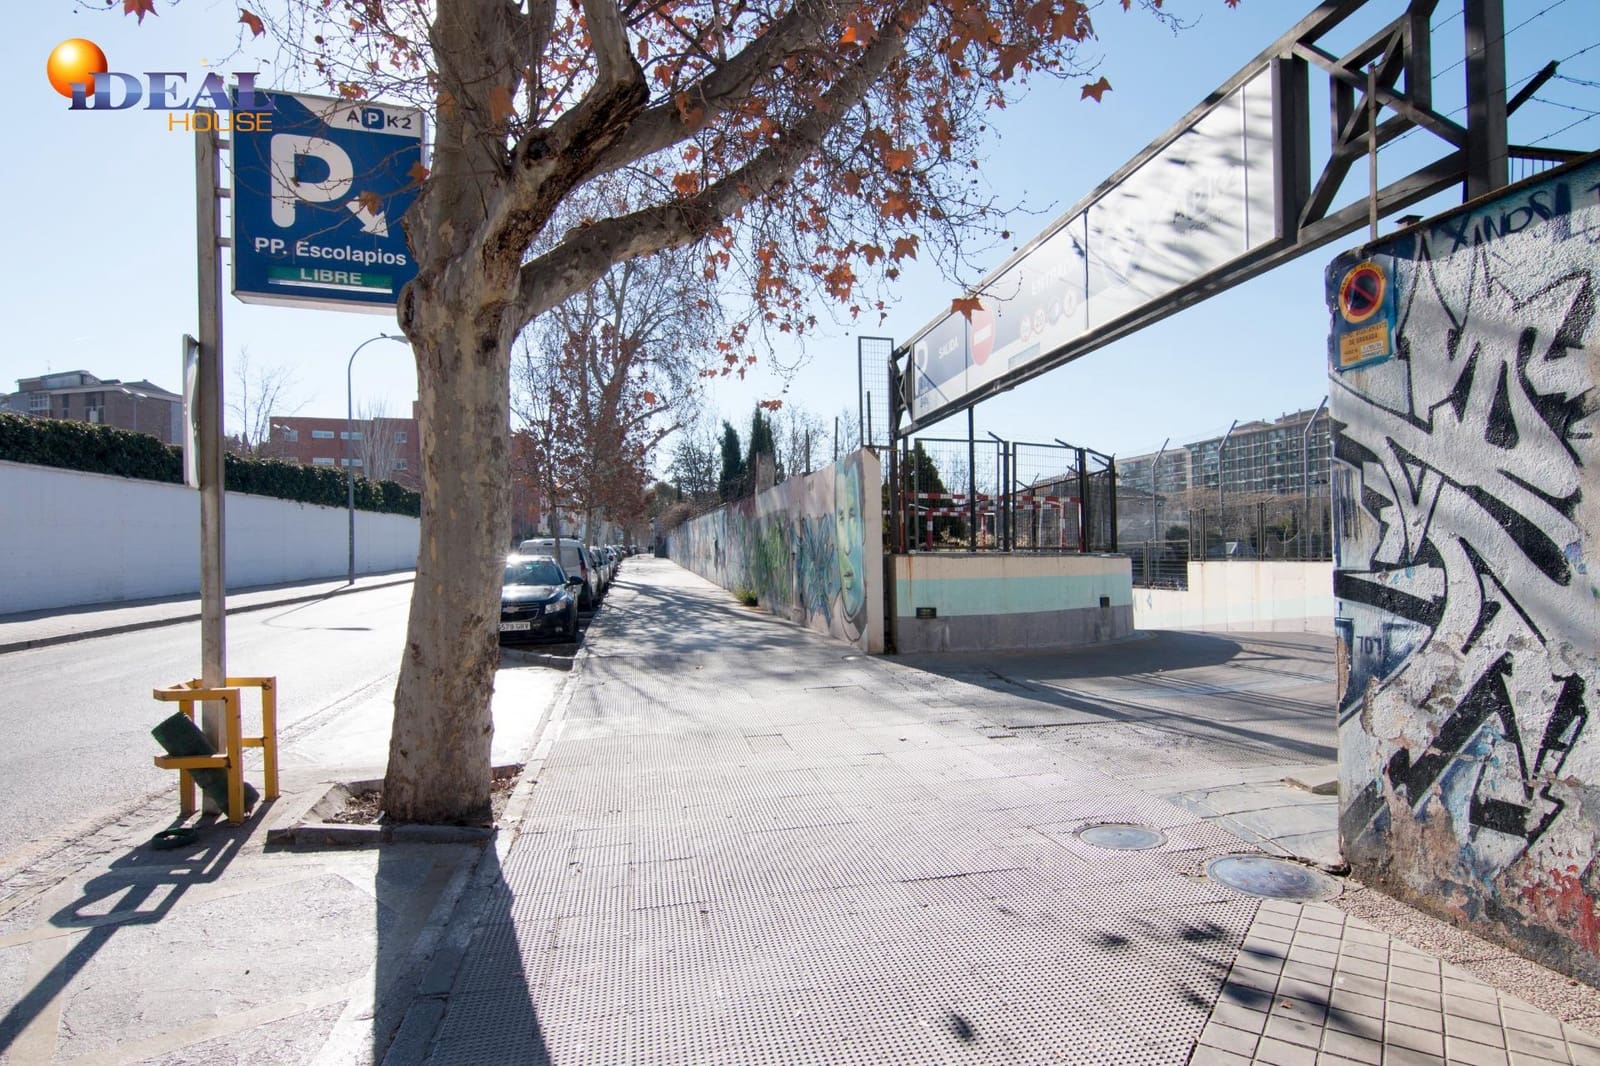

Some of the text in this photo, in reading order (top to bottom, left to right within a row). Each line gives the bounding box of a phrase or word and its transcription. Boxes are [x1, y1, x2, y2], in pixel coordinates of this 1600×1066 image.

[270, 133, 354, 228] P
[255, 237, 407, 266] PP. Escolapios
[300, 268, 363, 286] LIBRE
